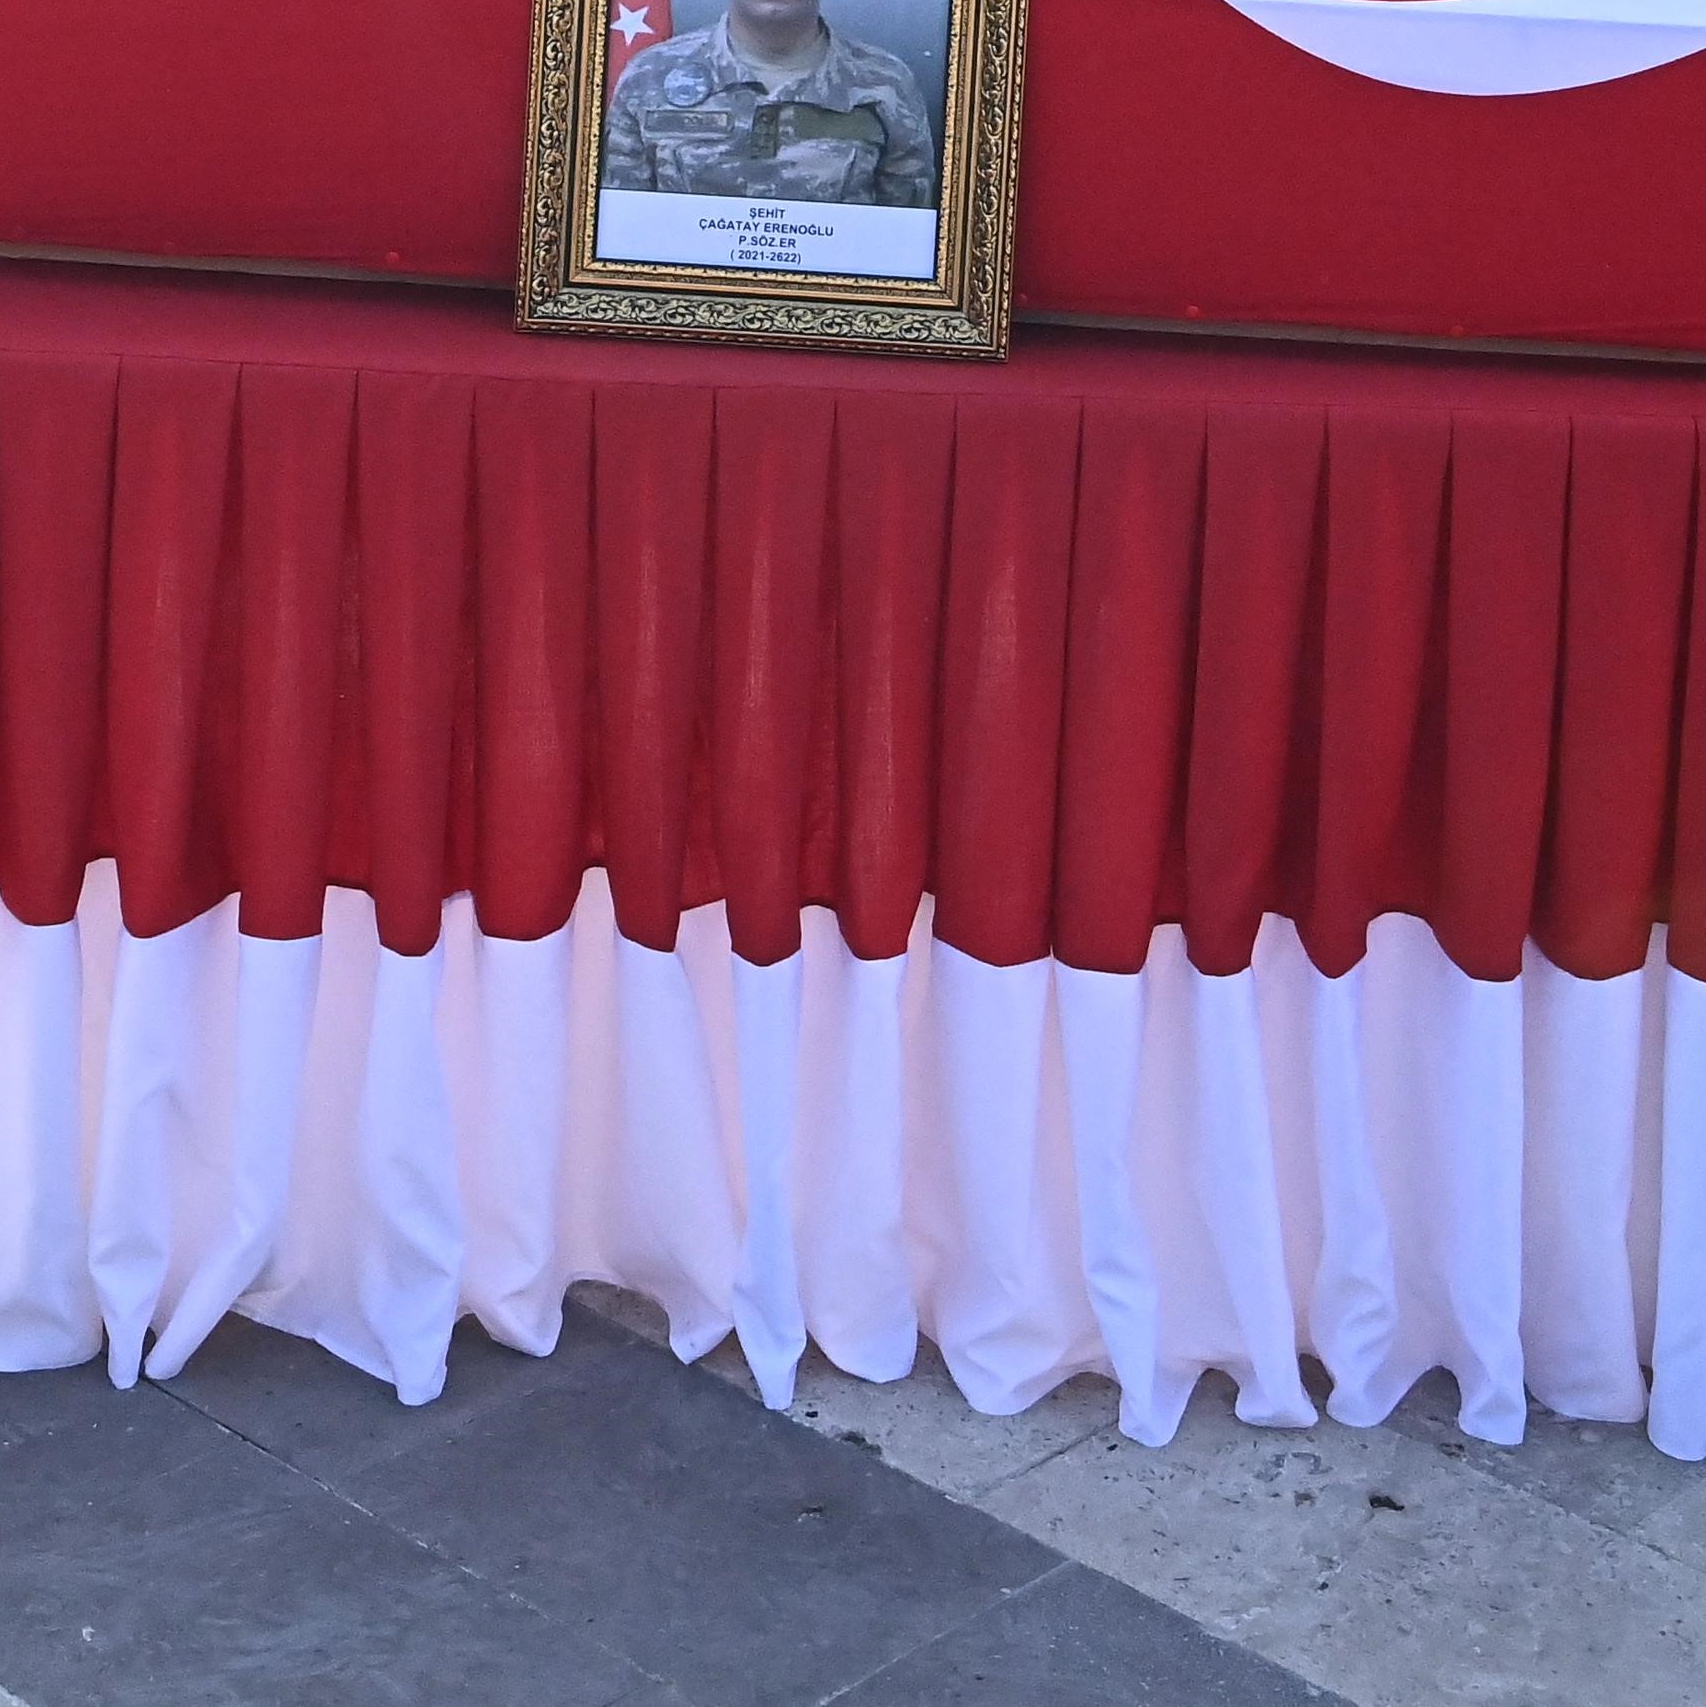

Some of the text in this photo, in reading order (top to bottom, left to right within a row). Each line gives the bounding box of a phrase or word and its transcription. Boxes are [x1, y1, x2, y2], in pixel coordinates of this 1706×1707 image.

[749, 207, 786, 219] ŞEHİT
[698, 218, 834, 236] ÇAĞATAY ERENOĞLU
